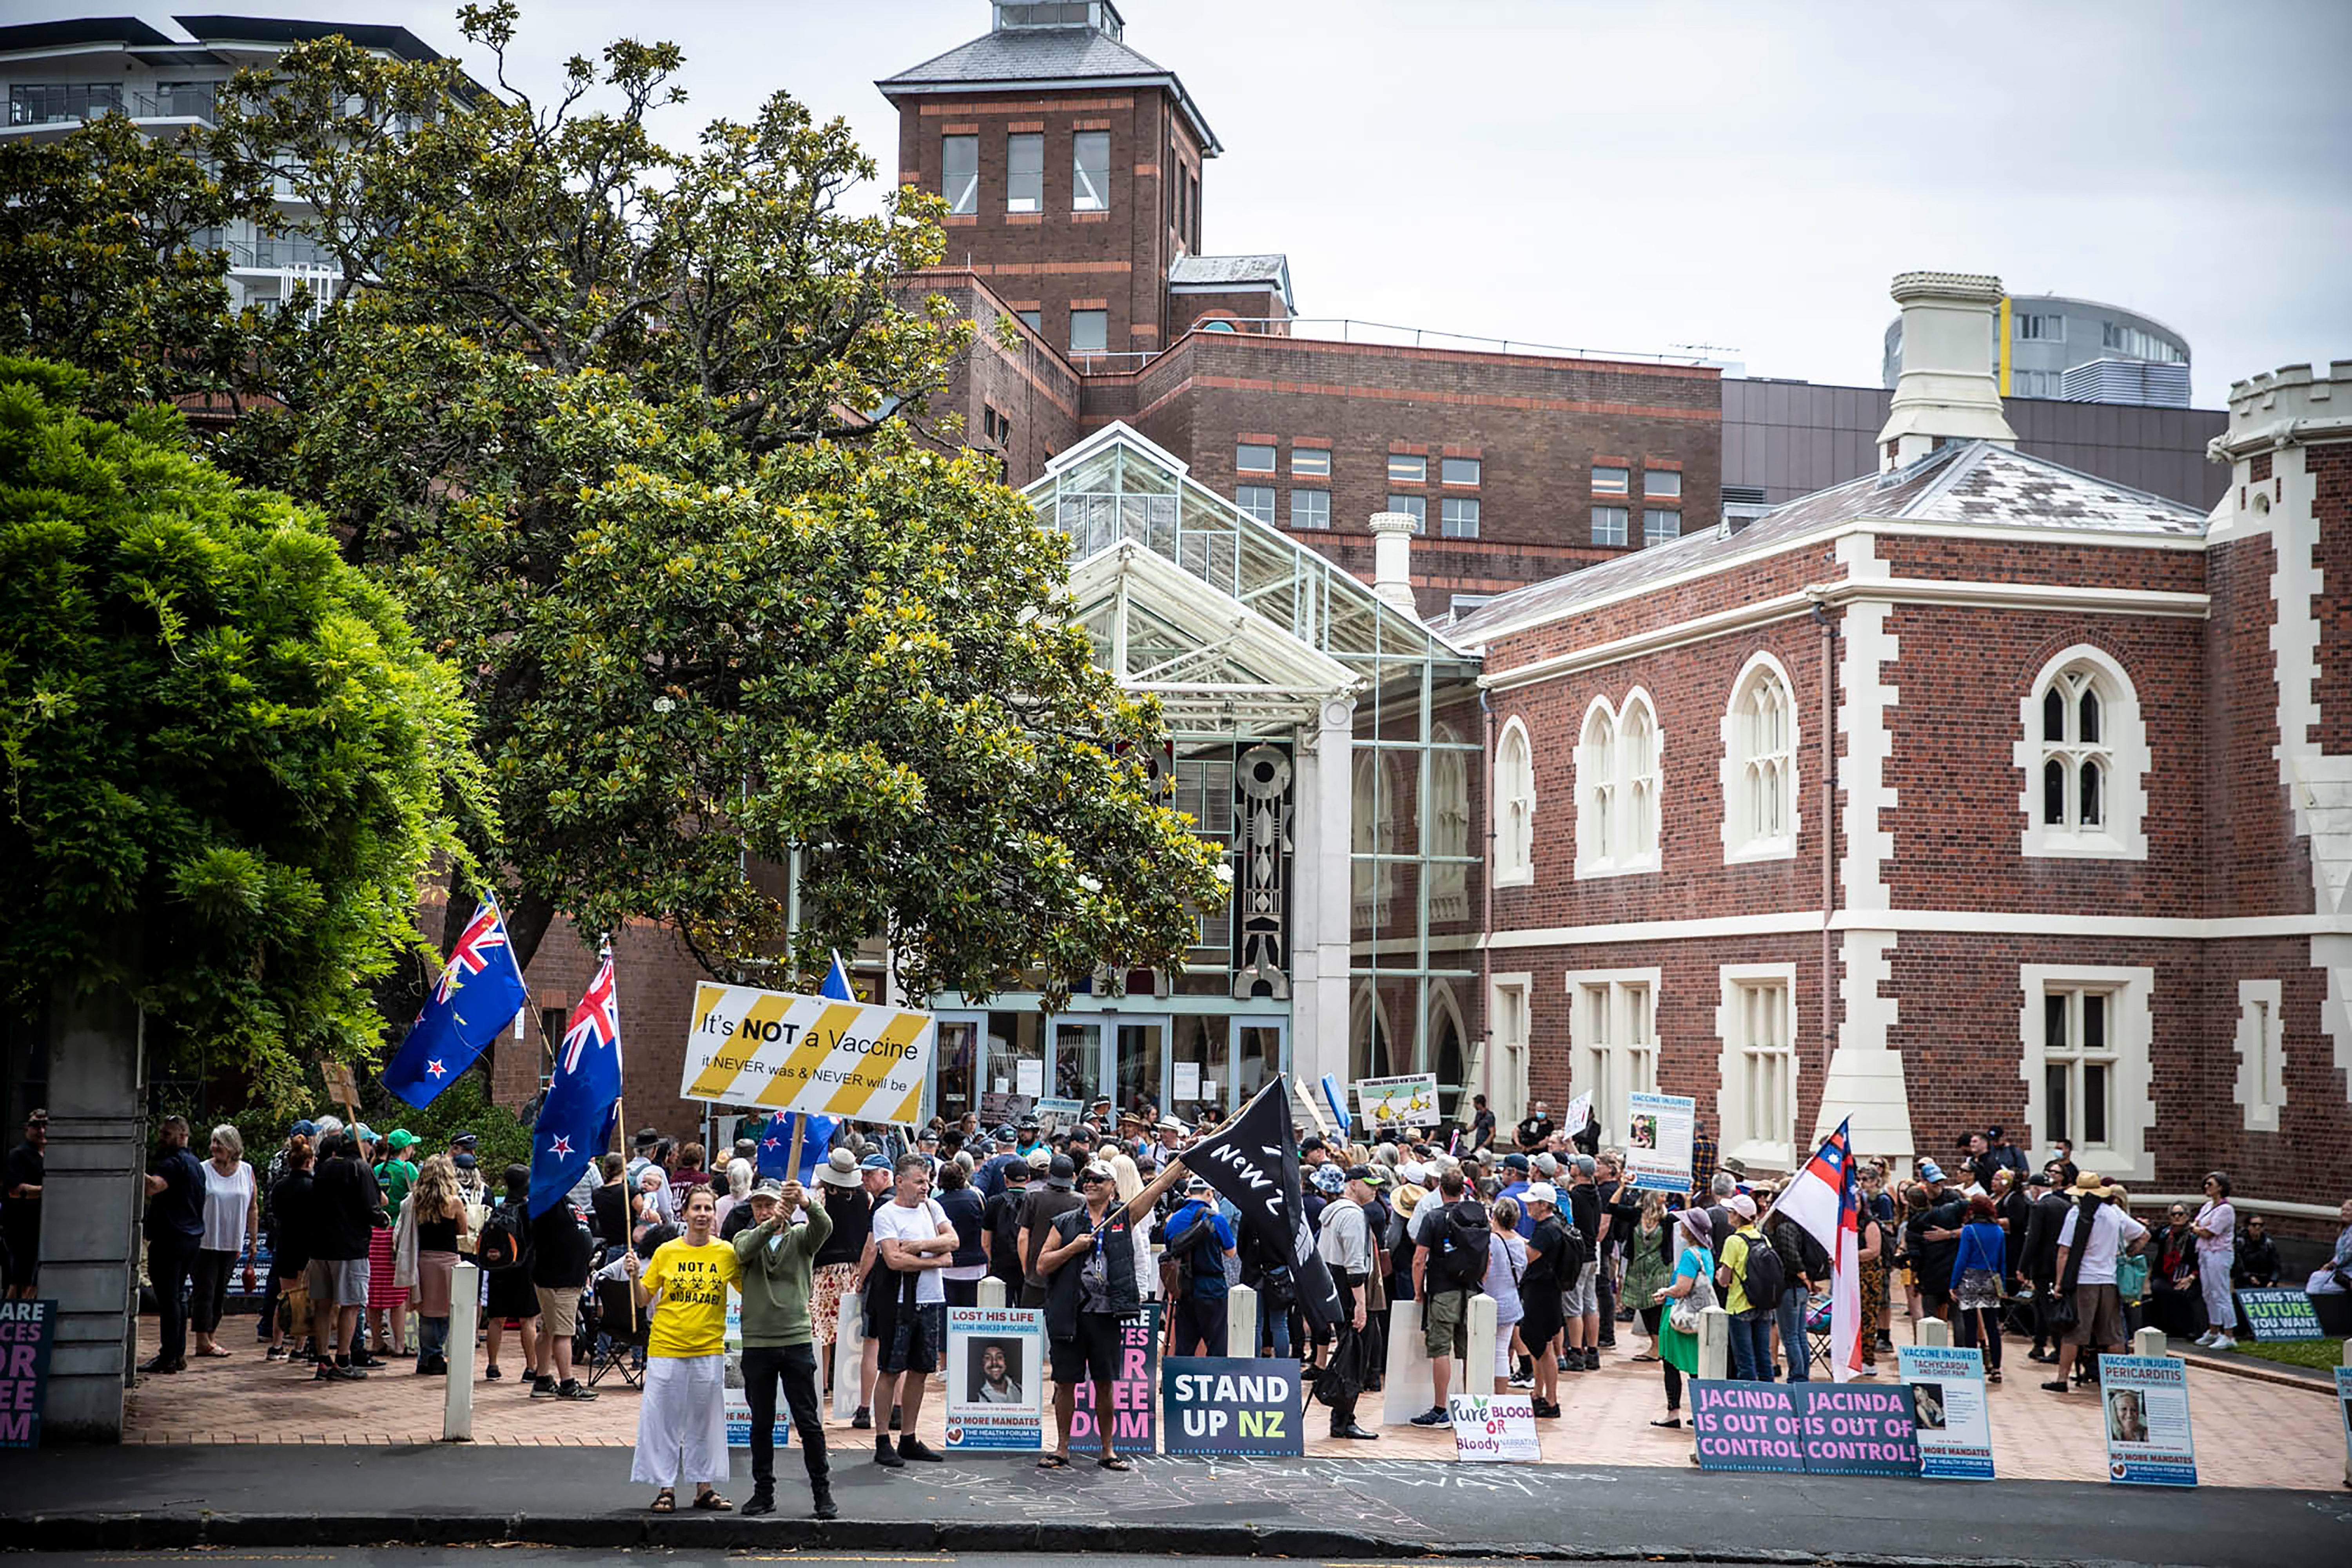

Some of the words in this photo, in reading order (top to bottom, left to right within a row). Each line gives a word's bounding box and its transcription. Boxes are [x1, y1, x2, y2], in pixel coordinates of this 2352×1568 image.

[702, 1013, 734, 1036] It's
[742, 1018, 799, 1044] NOT
[805, 1032, 819, 1047] a
[829, 1029, 918, 1060] Vaccine
[702, 1054, 709, 1067] it
[713, 1056, 764, 1073] NEVER
[768, 1066, 794, 1078] was
[799, 1067, 807, 1079] &
[812, 1070, 863, 1085] NEVER
[866, 1078, 887, 1089] will
[891, 1080, 907, 1091] be
[678, 1261, 704, 1272] NOT
[709, 1263, 717, 1273] A
[2241, 1293, 2254, 1302] IS
[2254, 1292, 2283, 1302] THIS
[2284, 1291, 2308, 1301] THE
[953, 1311, 983, 1320] LOST
[987, 1312, 1006, 1321] HIS
[1010, 1312, 1034, 1322] LIFE
[2245, 1302, 2314, 1318] FUTURE
[2249, 1318, 2278, 1328] YOU
[2279, 1317, 2317, 1328] WANT
[2255, 1328, 2273, 1337] FOR
[1902, 1348, 1939, 1358] VACCINE
[1942, 1349, 1978, 1360] INJURED
[2104, 1356, 2142, 1366] VACCINE
[2144, 1359, 2181, 1368] INJURED
[2105, 1367, 2181, 1381] PERICARDITIS
[1176, 1374, 1289, 1402] STAND
[1700, 1388, 1793, 1412] JACINDA
[1807, 1392, 1904, 1415] JACINDA
[1450, 1399, 1489, 1422] Pure
[1492, 1406, 1534, 1418] BLOOD
[949, 1416, 961, 1425] NO
[964, 1417, 989, 1425] MORE
[992, 1417, 1040, 1426] MANDATES
[1183, 1409, 1227, 1437] UP
[1238, 1410, 1285, 1438] NZ
[1486, 1419, 1507, 1434] OR
[1697, 1413, 1717, 1431] IS
[1723, 1414, 1768, 1433] OUT
[1775, 1417, 1801, 1435] OF
[1804, 1417, 1825, 1435] IS
[1831, 1417, 1878, 1436] OUT
[1884, 1419, 1912, 1437] OF
[1457, 1437, 1499, 1453] Bloody
[1808, 1441, 1917, 1462] CONTROL!
[1948, 1448, 1990, 1456] MANDATES
